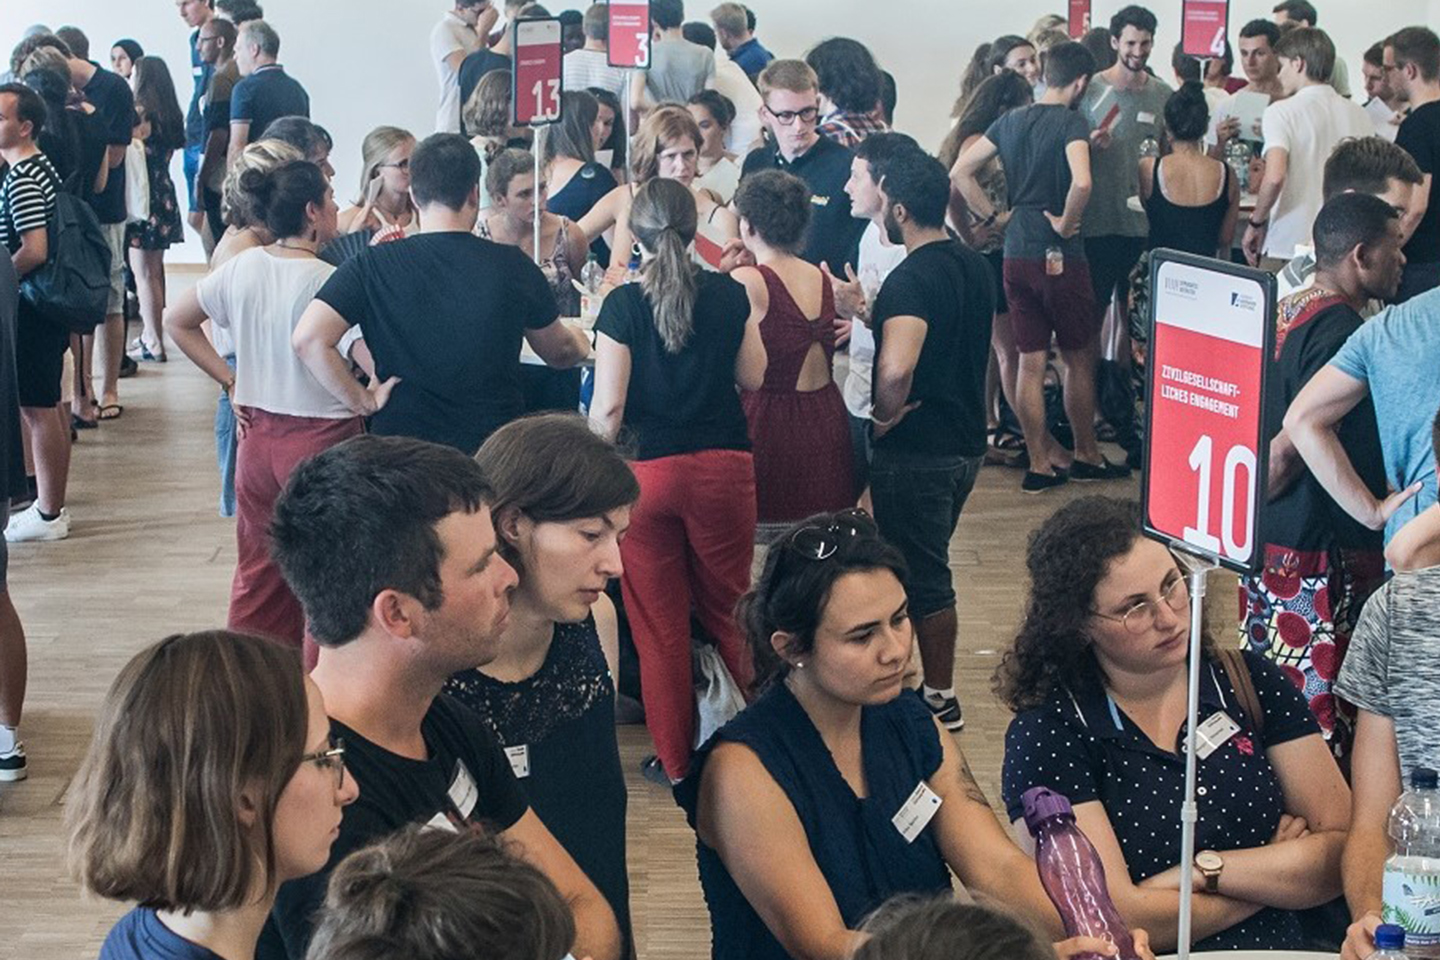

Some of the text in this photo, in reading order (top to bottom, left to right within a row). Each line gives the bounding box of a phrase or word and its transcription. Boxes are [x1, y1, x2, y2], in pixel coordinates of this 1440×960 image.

[634, 32, 649, 67] 3
[1210, 26, 1225, 57] 4
[530, 78, 560, 122] 13
[1161, 364, 1241, 397] ZIVILGESELLSCHAFT-
[1161, 384, 1239, 419] LICHES ENGAGEMENT
[1183, 434, 1258, 562] 10
